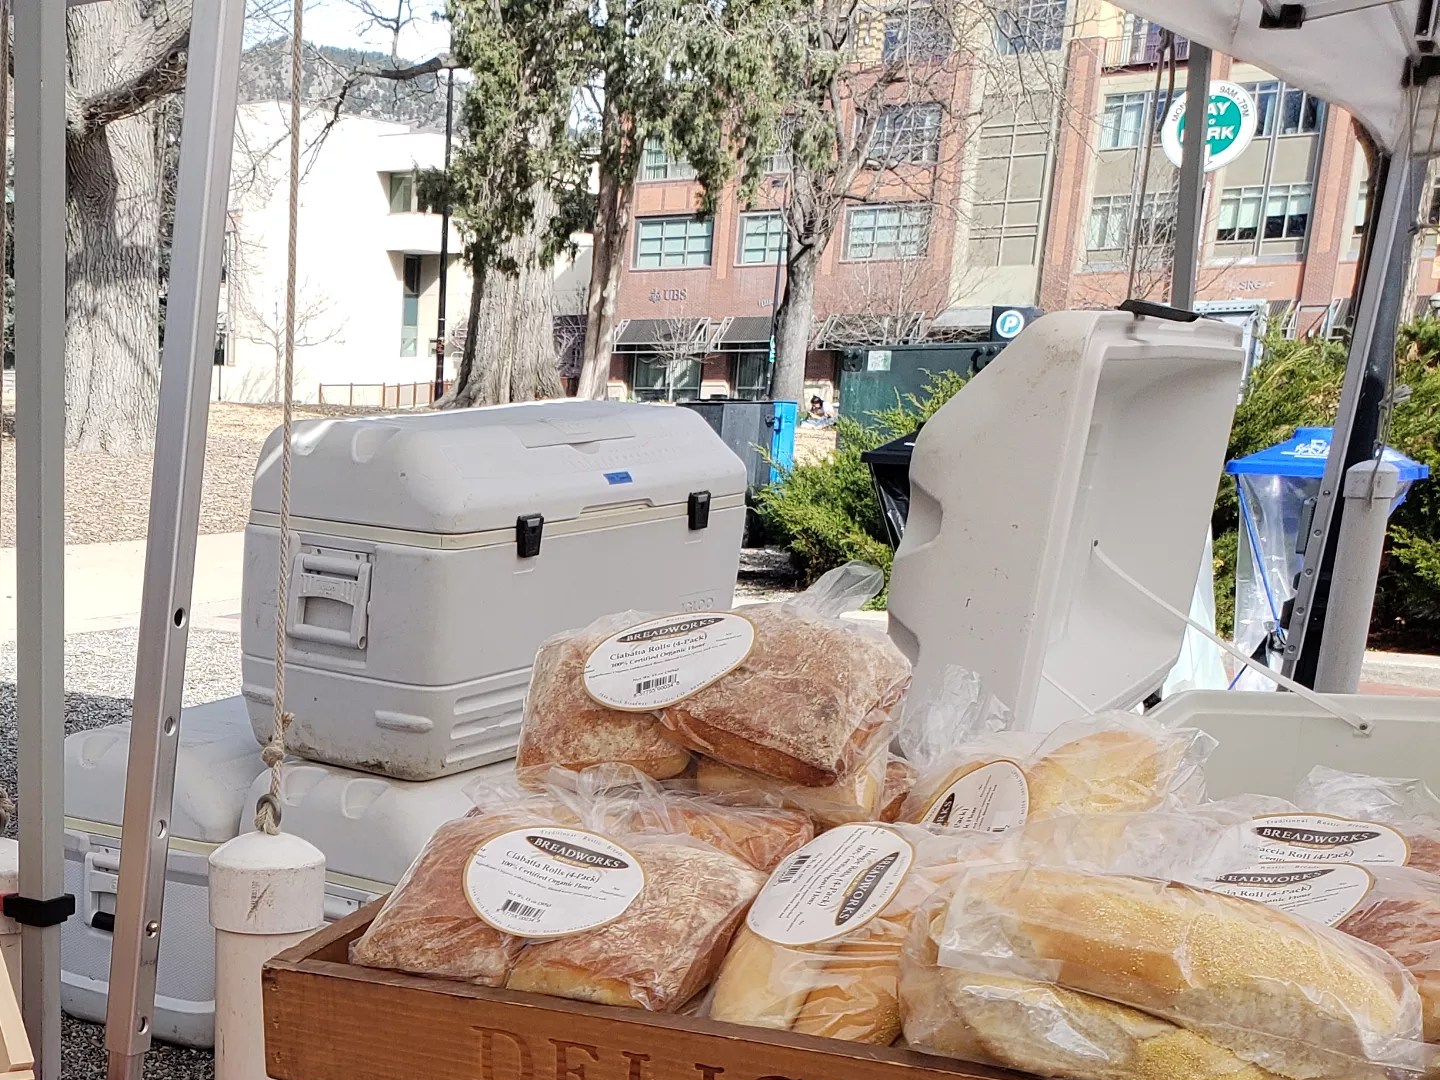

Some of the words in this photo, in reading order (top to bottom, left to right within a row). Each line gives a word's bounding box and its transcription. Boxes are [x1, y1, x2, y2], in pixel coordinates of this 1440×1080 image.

[663, 289, 687, 301] UBS
[626, 618, 716, 642] BREADWORKS
[609, 649, 647, 661] Ciabatta
[648, 643, 671, 653] Rolls
[1262, 828, 1370, 845] BREADWORKS
[533, 837, 621, 868] BREADWORKS
[1288, 850, 1310, 860] Roll
[1313, 849, 1354, 860] (4-Pack)
[505, 850, 542, 870] Ciabatta
[543, 863, 565, 876] Rolls
[565, 870, 601, 884] (4-Pack)
[1217, 870, 1322, 883] READWORKS
[839, 855, 896, 921] BREADWORKS
